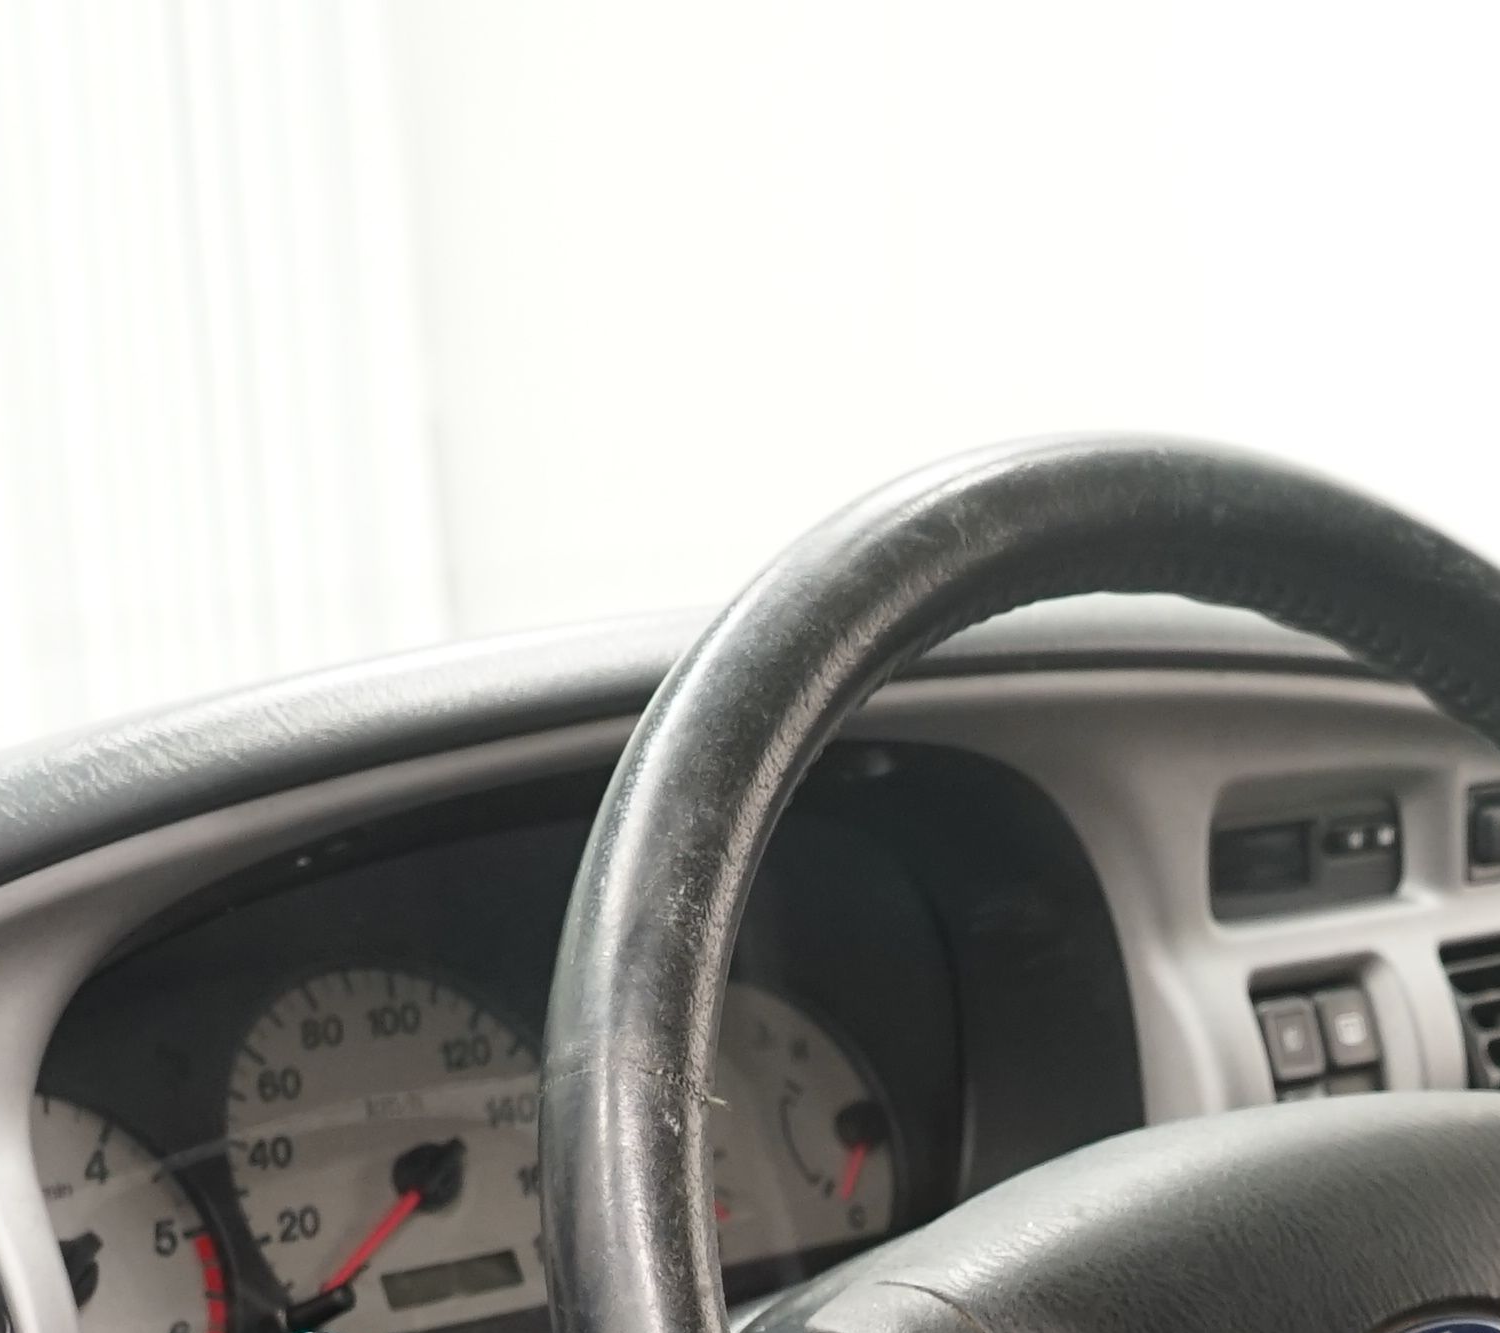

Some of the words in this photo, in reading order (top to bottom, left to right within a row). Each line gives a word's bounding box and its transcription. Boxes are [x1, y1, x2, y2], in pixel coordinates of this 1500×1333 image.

[301, 1014, 343, 1048] 80
[368, 1003, 421, 1036] 100
[442, 1034, 491, 1071] 120
[257, 1068, 301, 1101] 60
[85, 1150, 110, 1184] 4
[249, 1136, 292, 1170] 40
[154, 1219, 177, 1257] 5
[276, 1205, 320, 1243] 20
